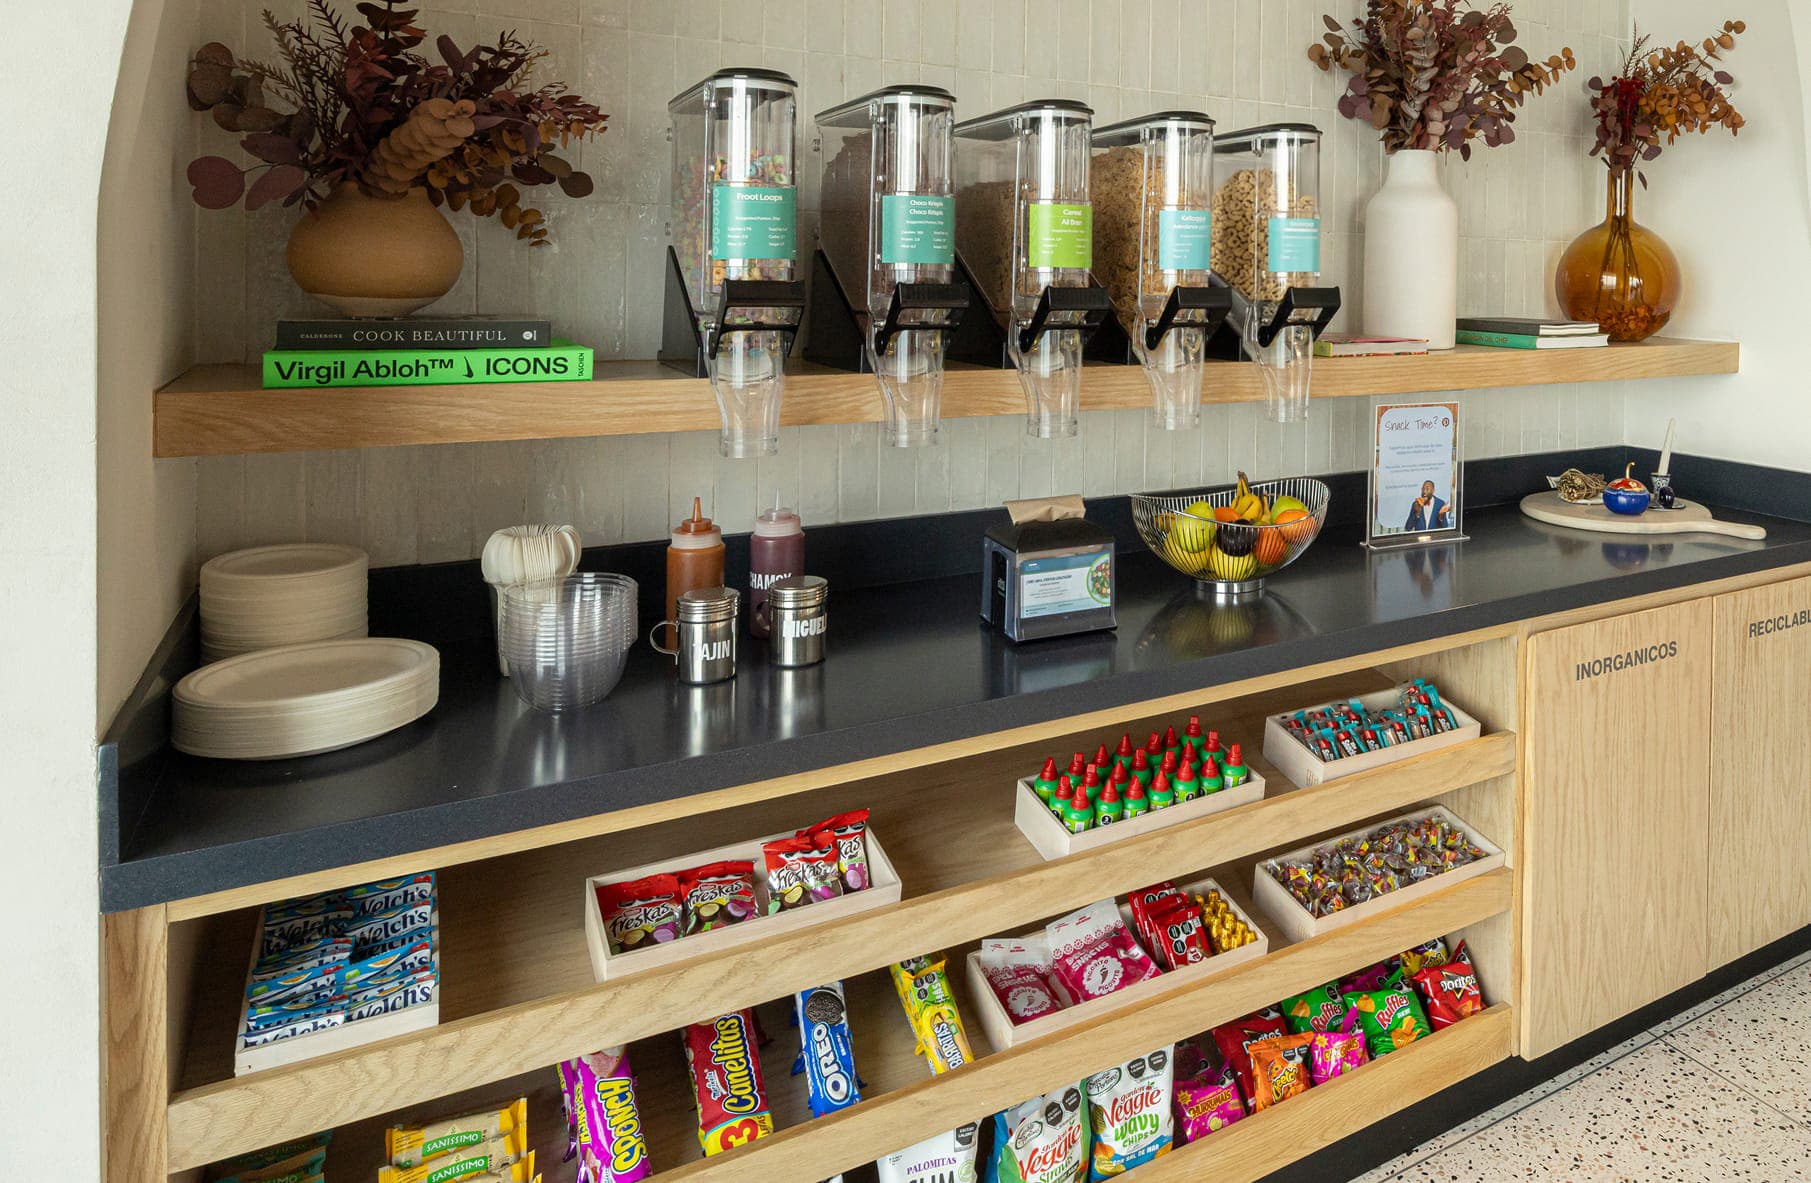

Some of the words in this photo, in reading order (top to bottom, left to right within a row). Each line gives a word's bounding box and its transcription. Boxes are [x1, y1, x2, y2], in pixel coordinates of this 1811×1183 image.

[736, 192, 759, 201] Froot
[760, 193, 783, 202] Loops
[353, 330, 405, 341] COOK
[413, 329, 507, 341] BEAUTIFUL
[274, 360, 346, 385] Virgil
[485, 356, 569, 376] ICONS
[1384, 419, 1410, 432] Snack
[693, 639, 731, 661] AJIN
[1576, 641, 1678, 681] INORGANICOS
[1441, 974, 1477, 992] Doritos
[1311, 1002, 1343, 1031] Ruffles
[1376, 994, 1409, 1029] Ruffles
[934, 1023, 965, 1070] BARRITAS
[711, 1018, 756, 1112] Canelitas
[813, 1023, 848, 1100] OREO
[1103, 1088, 1162, 1128] Veggie
[598, 1079, 647, 1172] SPONCH
[720, 1118, 759, 1151] 3
[1114, 1113, 1160, 1141] wavy
[426, 1133, 479, 1153] SANISSIMO
[1019, 1123, 1081, 1181] Veggie
[1122, 1133, 1150, 1148] CHIPS
[431, 1158, 485, 1183] SANISSIMO
[906, 1157, 957, 1175] PALOMITAS
